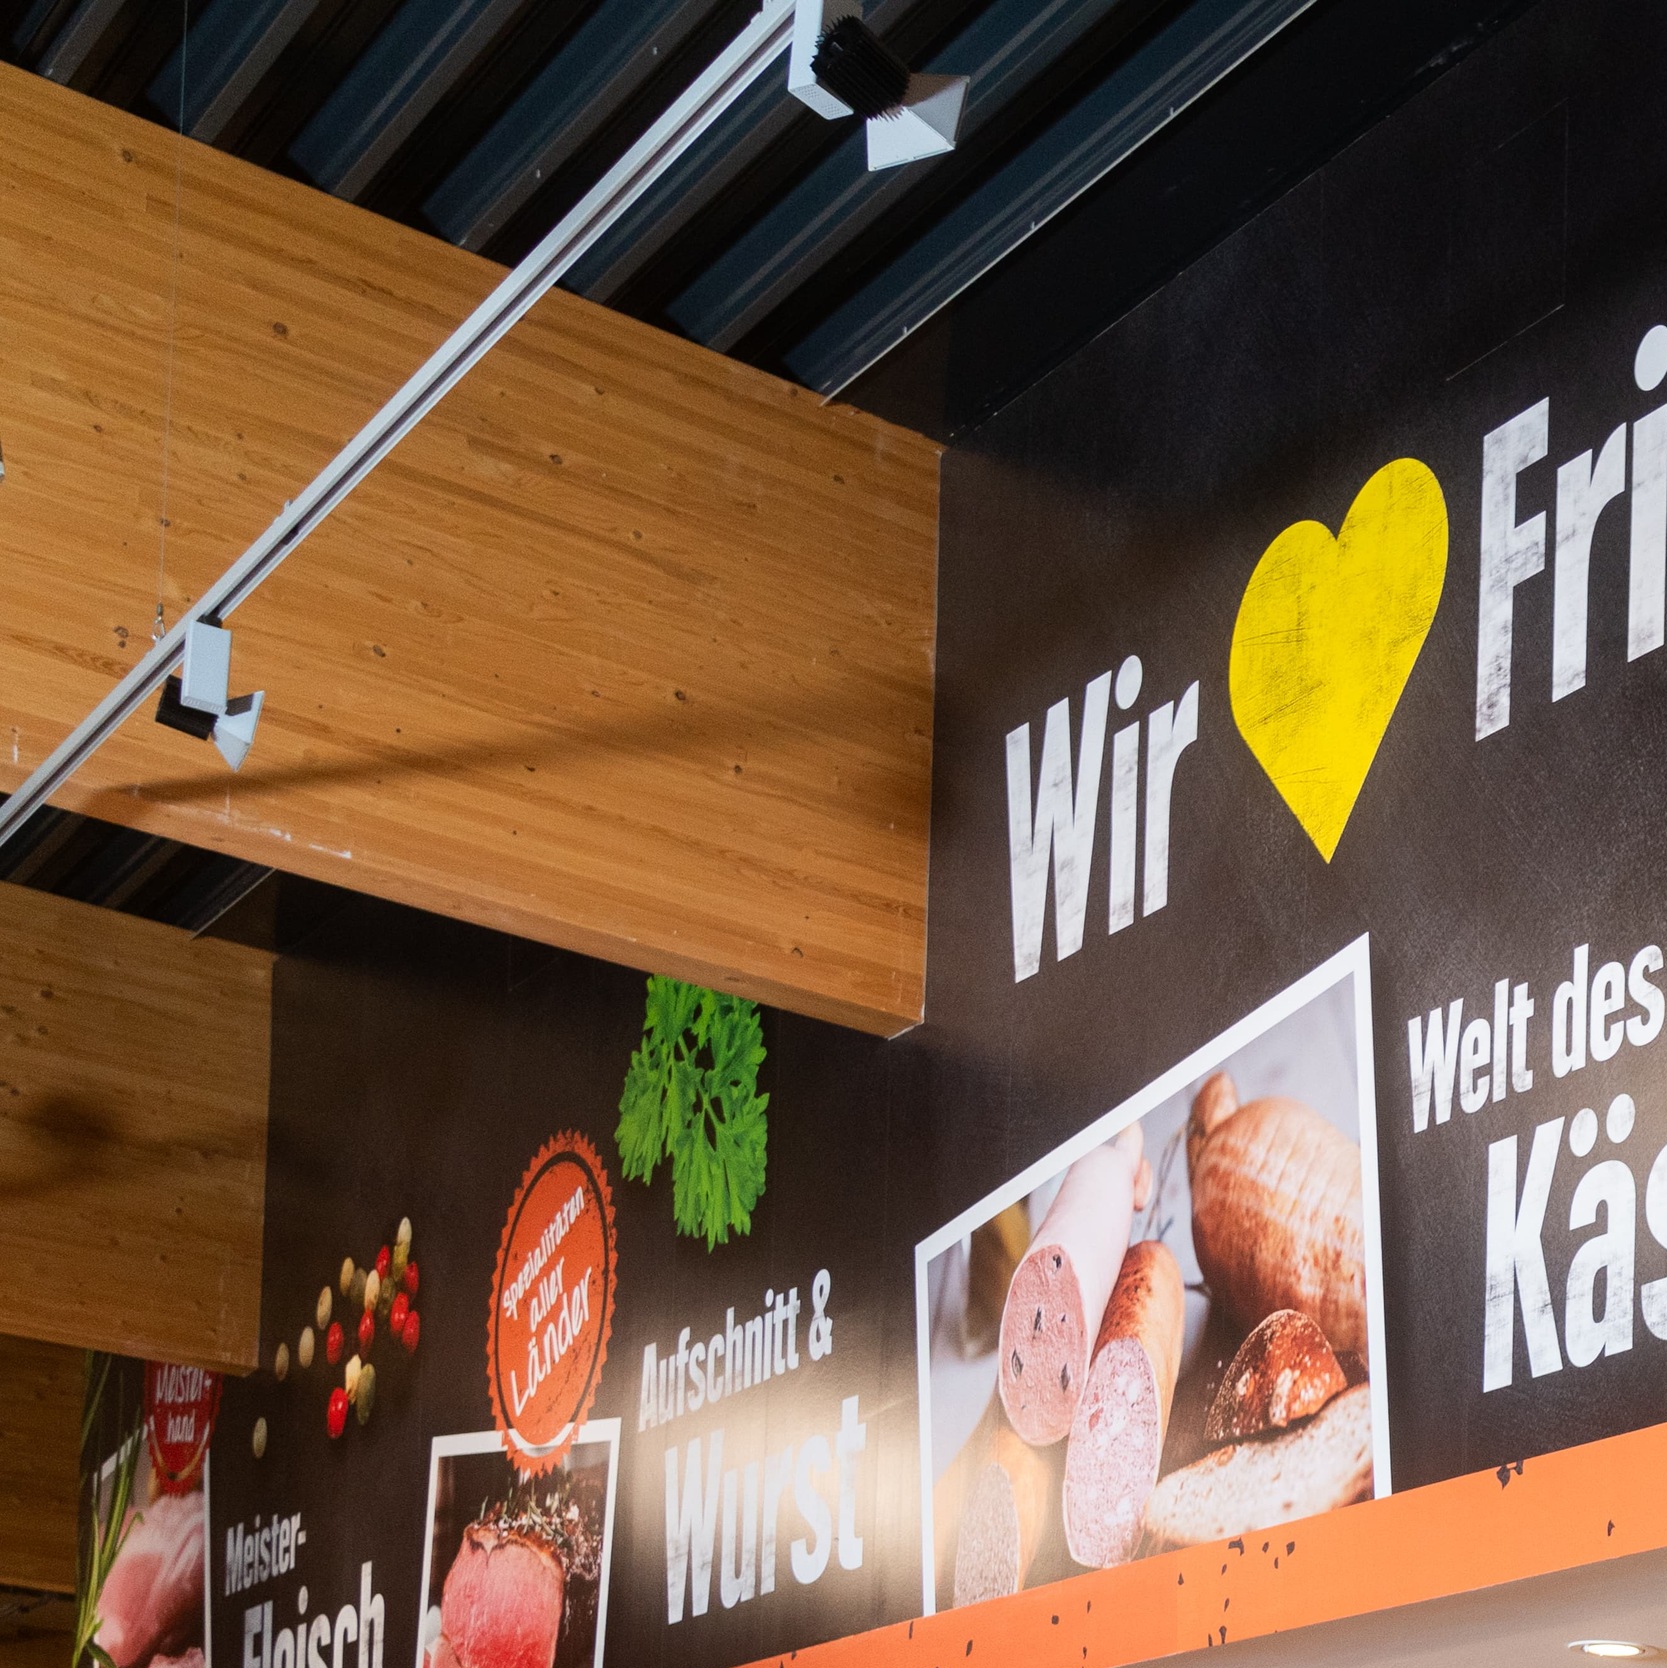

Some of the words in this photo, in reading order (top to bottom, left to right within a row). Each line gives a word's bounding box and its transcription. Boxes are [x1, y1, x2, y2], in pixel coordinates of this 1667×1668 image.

[1004, 655, 1200, 985] Wir
[1407, 976, 1534, 1134] Welt
[1551, 943, 1666, 1075] des
[511, 1266, 592, 1417] Länder
[638, 1279, 803, 1433] Aufschnitt
[808, 1268, 834, 1361] &
[225, 1503, 308, 1597] Meister-
[663, 1394, 865, 1626] Wurst
